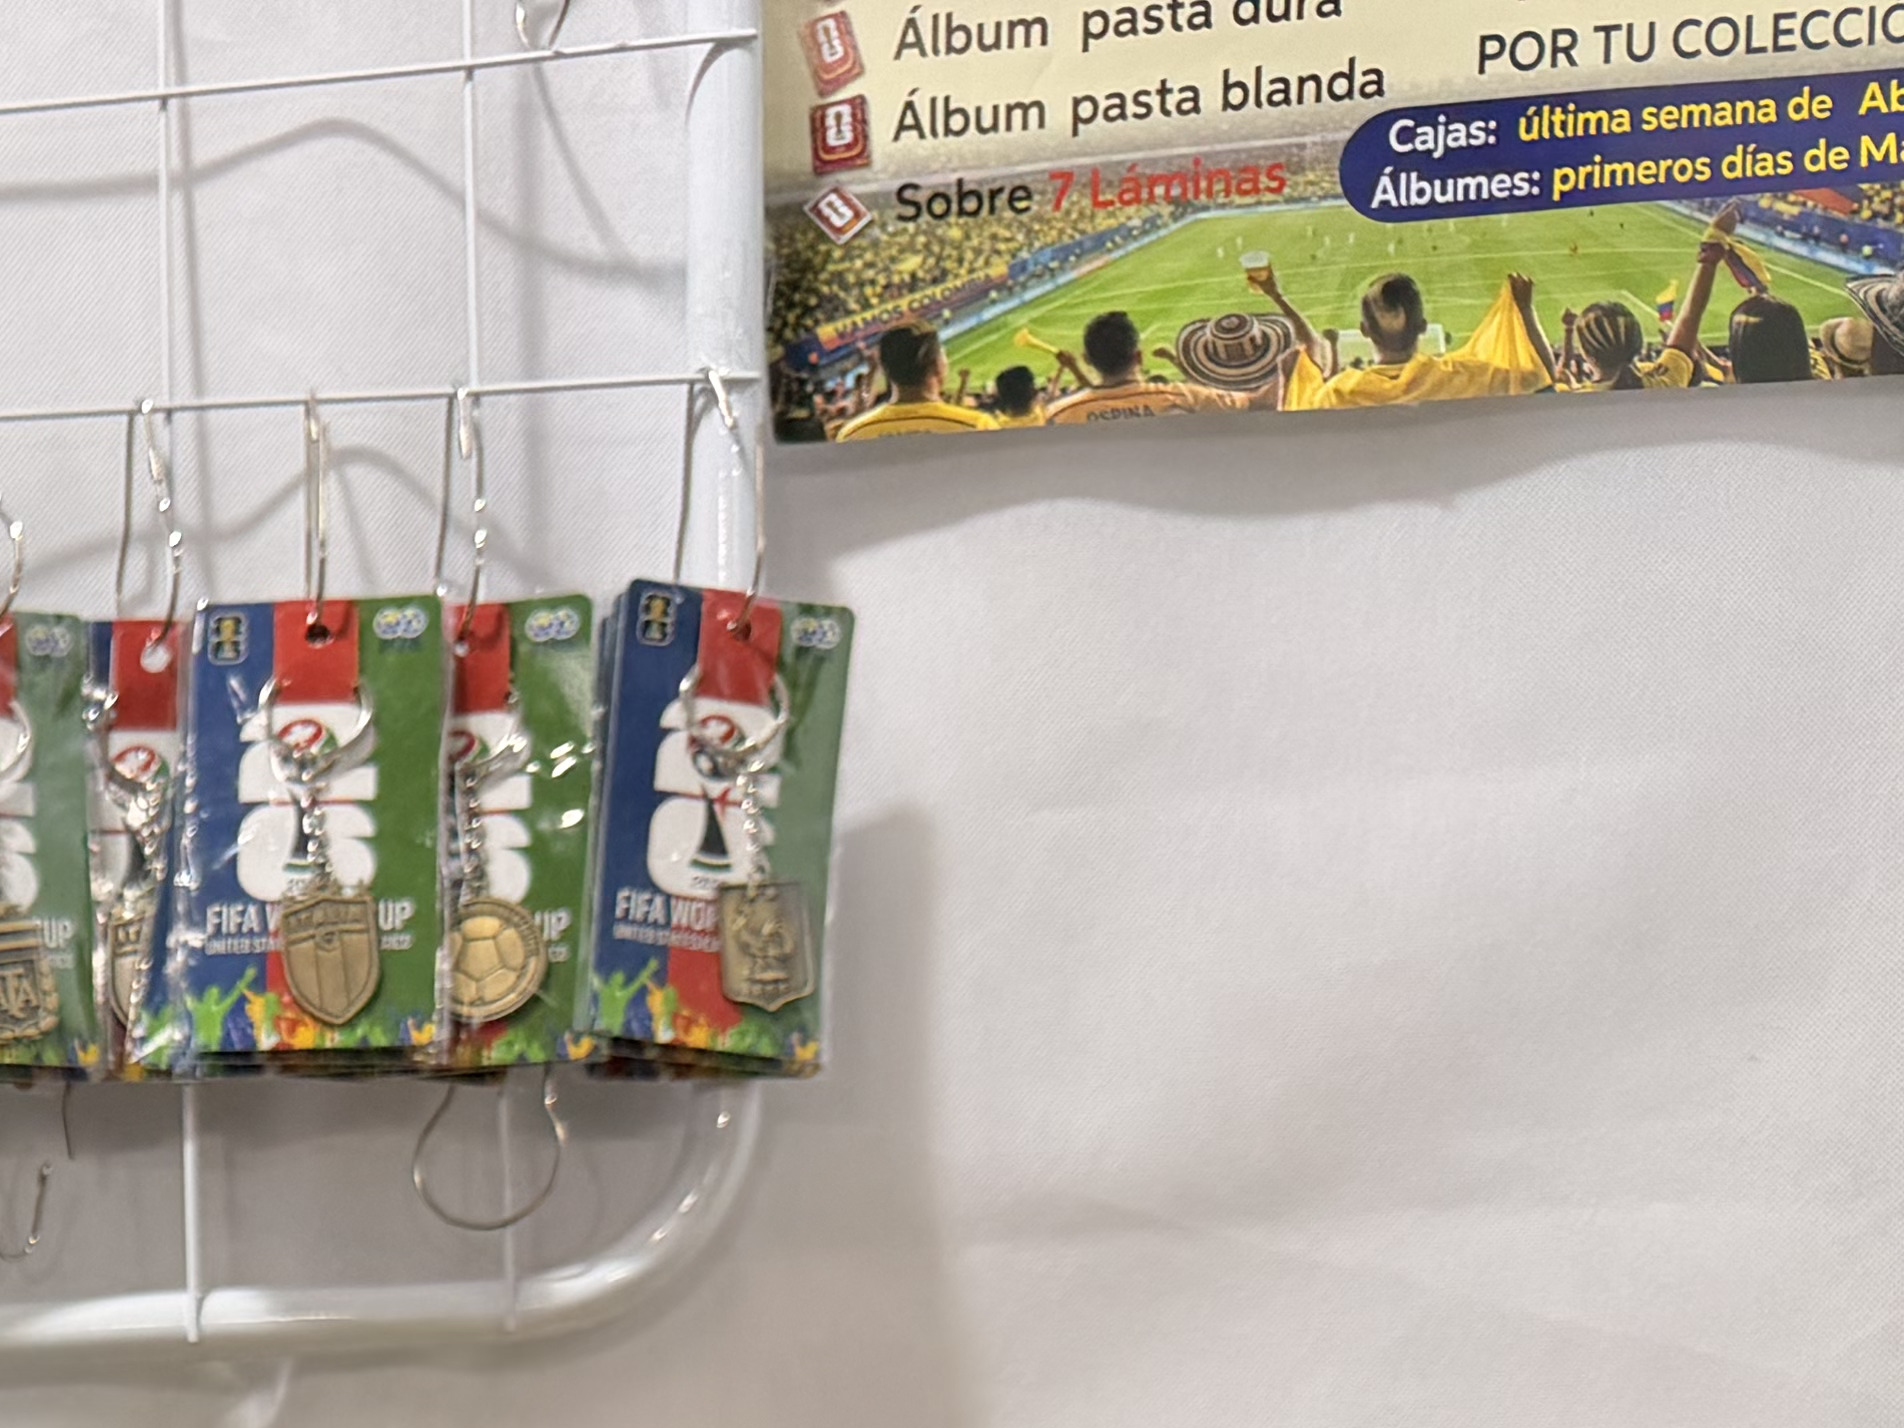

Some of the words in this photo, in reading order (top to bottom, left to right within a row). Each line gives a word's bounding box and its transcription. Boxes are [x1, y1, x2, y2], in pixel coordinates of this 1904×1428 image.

[894, 5, 1049, 61] Álbum
[1082, 0, 1212, 52] pasta
[1477, 28, 1579, 75] POR
[1593, 20, 1656, 64] TU
[1672, 4, 1904, 59] COLECCIO
[893, 88, 1046, 142] Álbum
[1071, 79, 1201, 137] pasta
[1221, 56, 1386, 112] blanda
[1388, 115, 1498, 158] Cajas:
[1518, 103, 1632, 142] última
[1641, 97, 1778, 132] semana
[1787, 85, 1834, 121] de
[1858, 79, 1904, 116] Ab
[896, 178, 1033, 223] Sobre
[1049, 171, 1075, 212] 7
[1091, 157, 1287, 209] Láminas
[1370, 167, 1542, 210] Álbumes:
[1552, 154, 1712, 201] primeros
[1721, 143, 1794, 181] días
[1803, 137, 1851, 173] de
[43, 917, 74, 949] UP
[205, 902, 261, 934] FIFA
[377, 898, 415, 931] UP
[615, 887, 667, 925] FIFA
